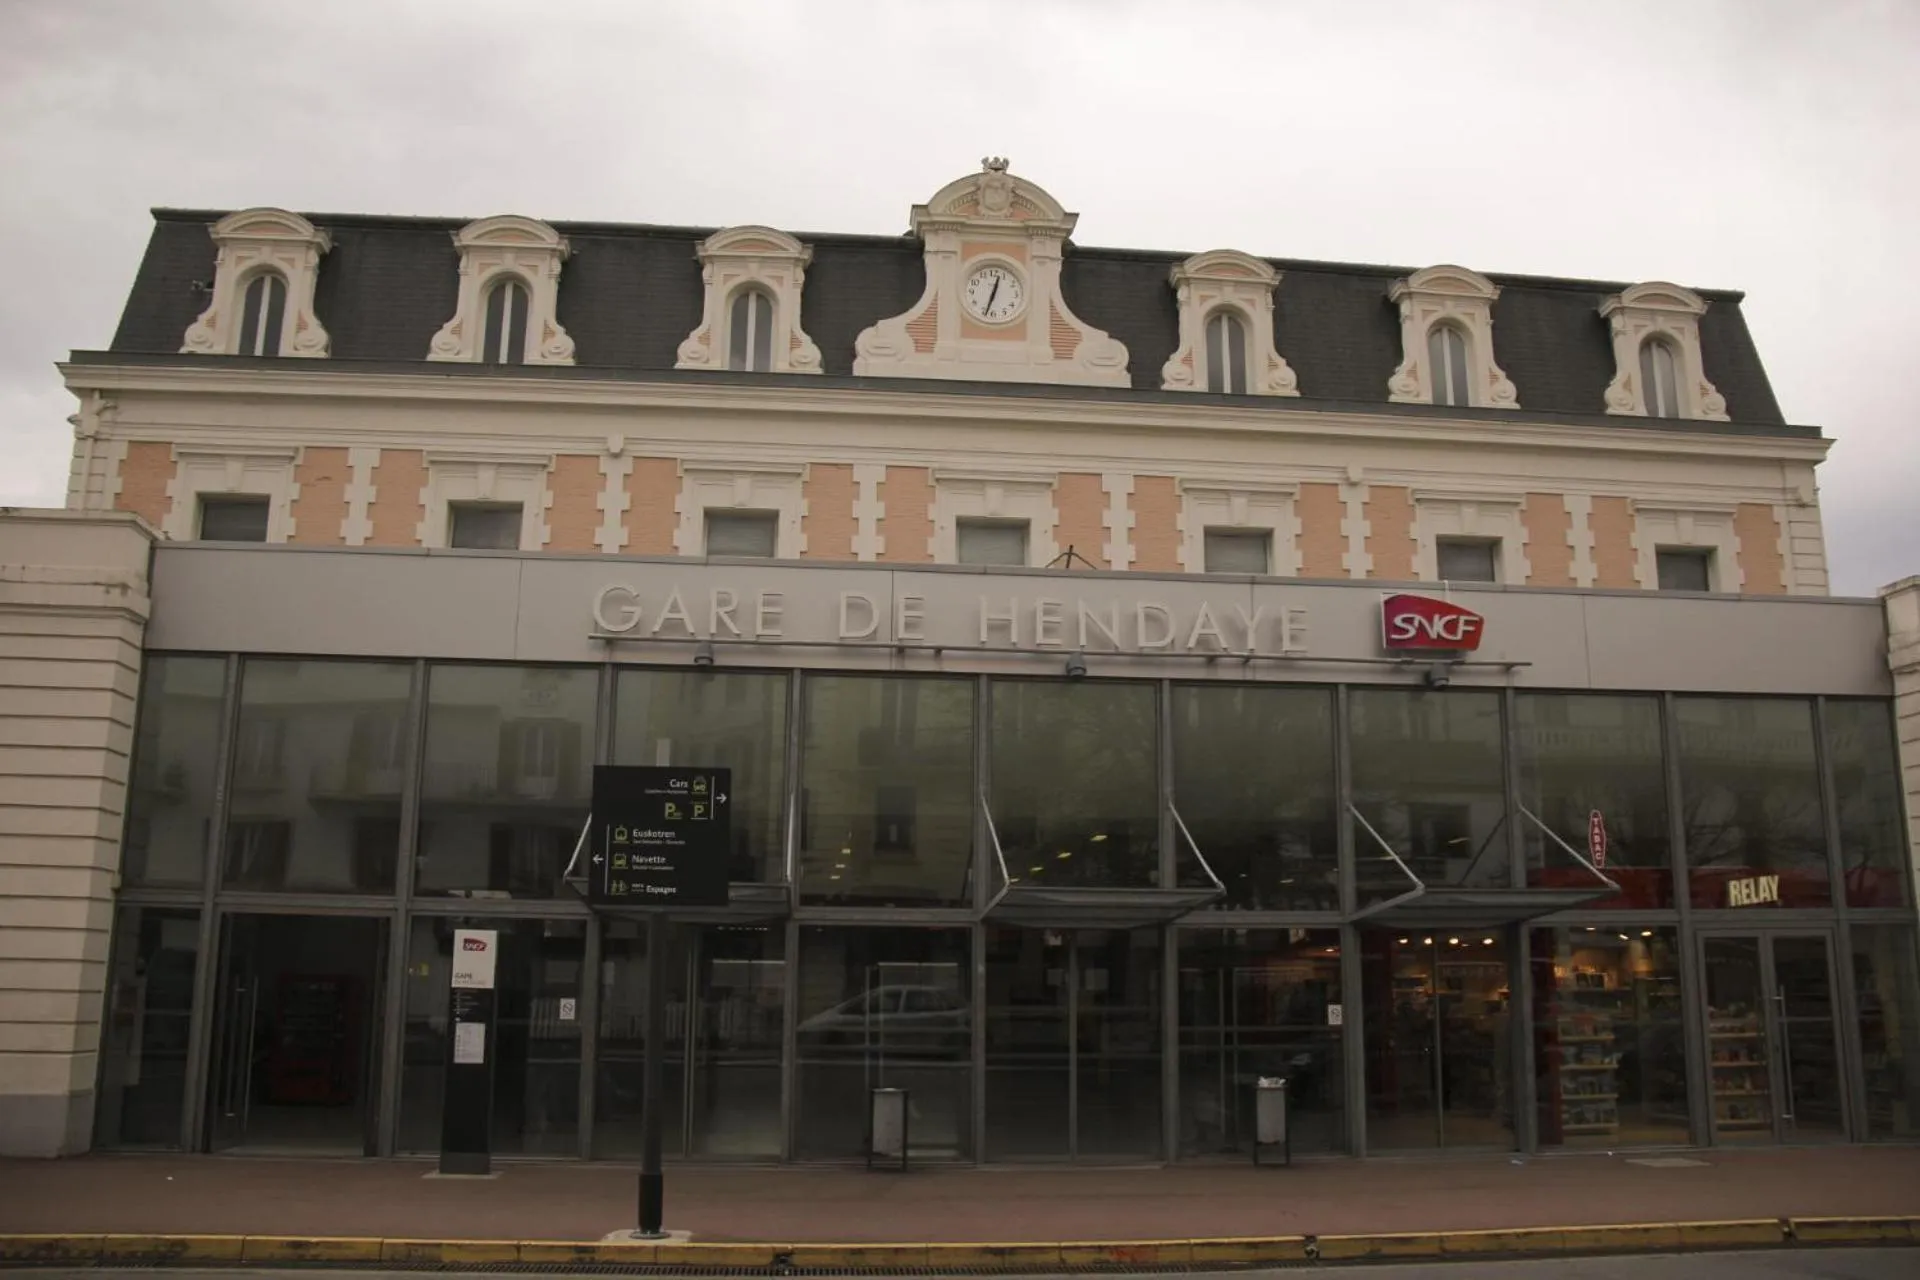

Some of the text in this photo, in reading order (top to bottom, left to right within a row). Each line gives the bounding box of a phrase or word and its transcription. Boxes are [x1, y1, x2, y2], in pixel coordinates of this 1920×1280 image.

[592, 584, 1309, 656] GARE DE HENDAYE
[1390, 613, 1480, 640] SNCF
[669, 779, 688, 788] Cars
[632, 828, 676, 838] Euskotren
[1592, 818, 1603, 860] TABAC
[631, 854, 667, 864] Navette
[646, 886, 676, 894] Espagne
[1728, 875, 1779, 907] RELAY
